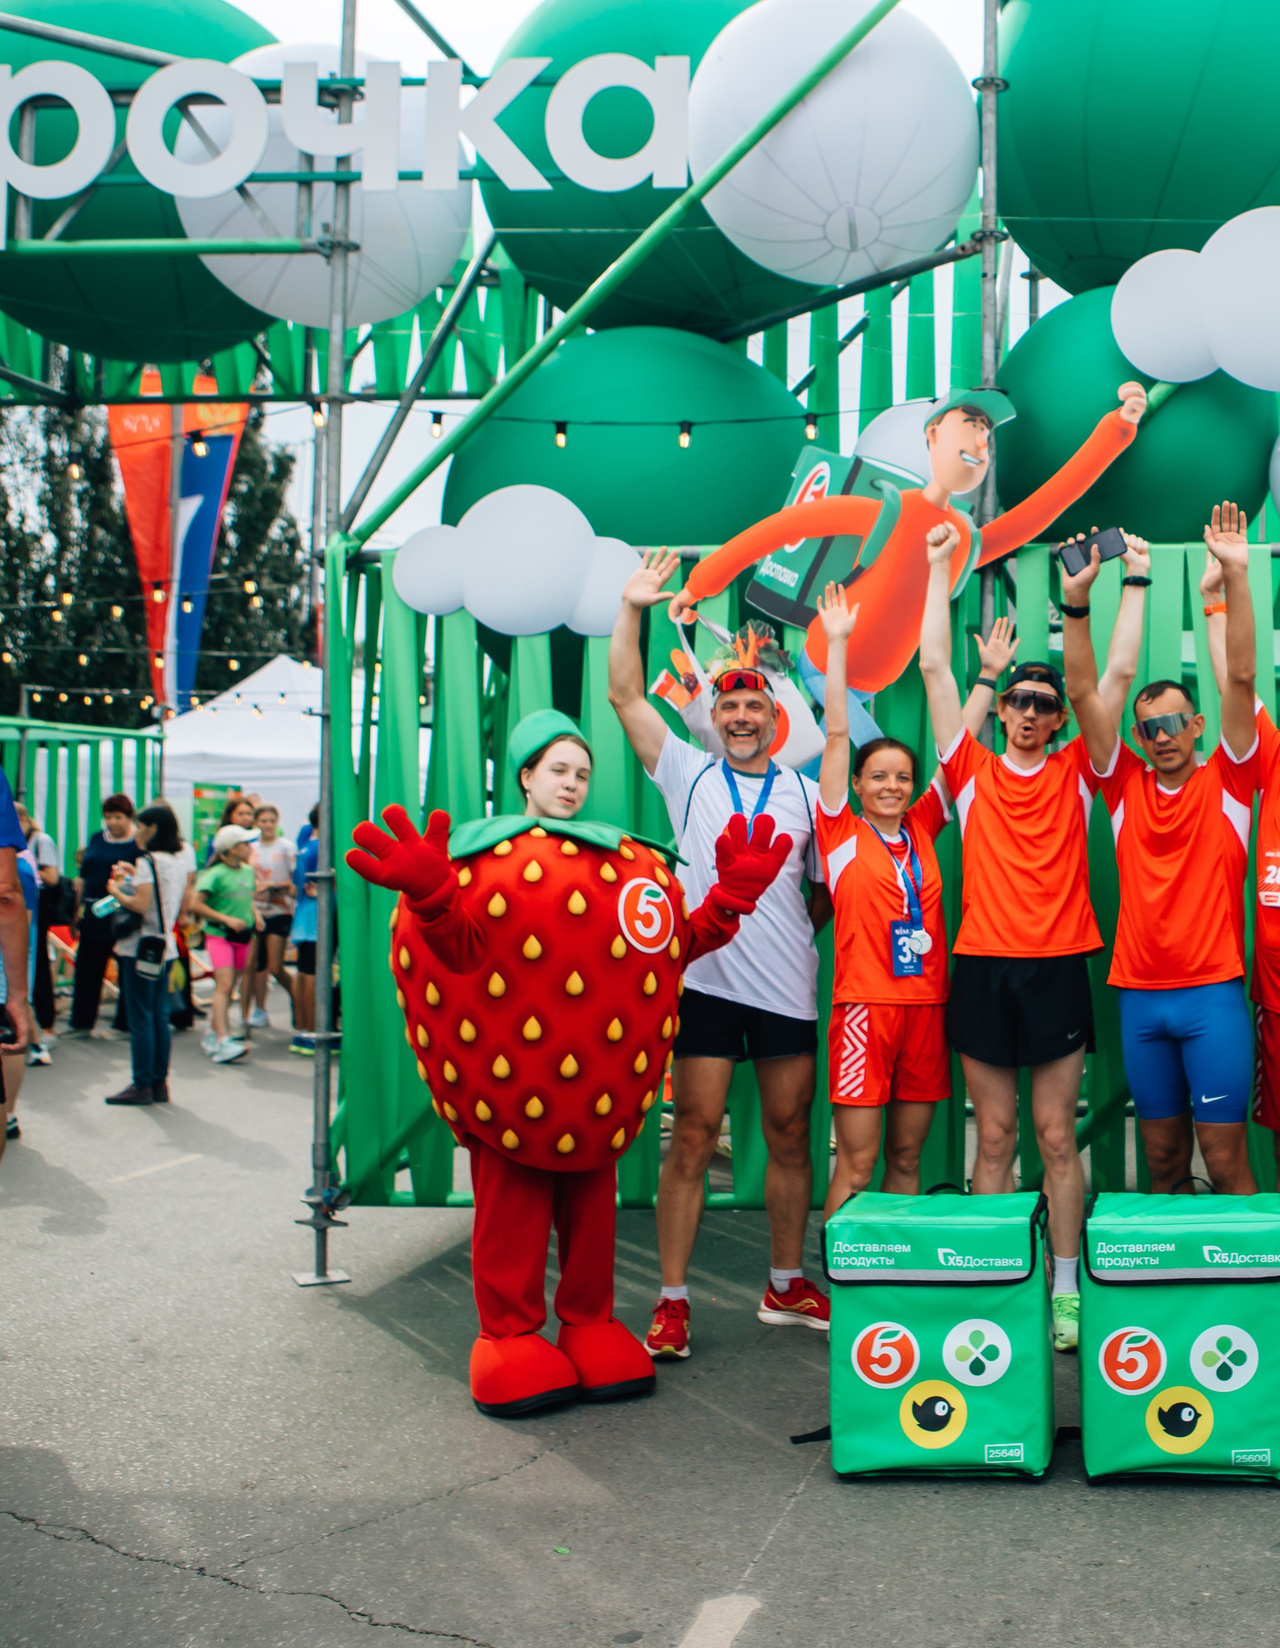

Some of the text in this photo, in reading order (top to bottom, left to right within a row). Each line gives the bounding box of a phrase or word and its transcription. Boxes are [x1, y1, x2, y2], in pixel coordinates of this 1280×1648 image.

[759, 554, 799, 588] Доставка
[634, 885, 664, 939] 5
[832, 1241, 911, 1254] Доставляем
[1096, 1242, 1176, 1254] Доставляем
[832, 1256, 895, 1267] продукты
[1096, 1255, 1160, 1268] продукты
[869, 1327, 903, 1377] 5
[1115, 1332, 1150, 1382] 5
[988, 1449, 1021, 1458] 25649
[1235, 1453, 1268, 1463] 25600
